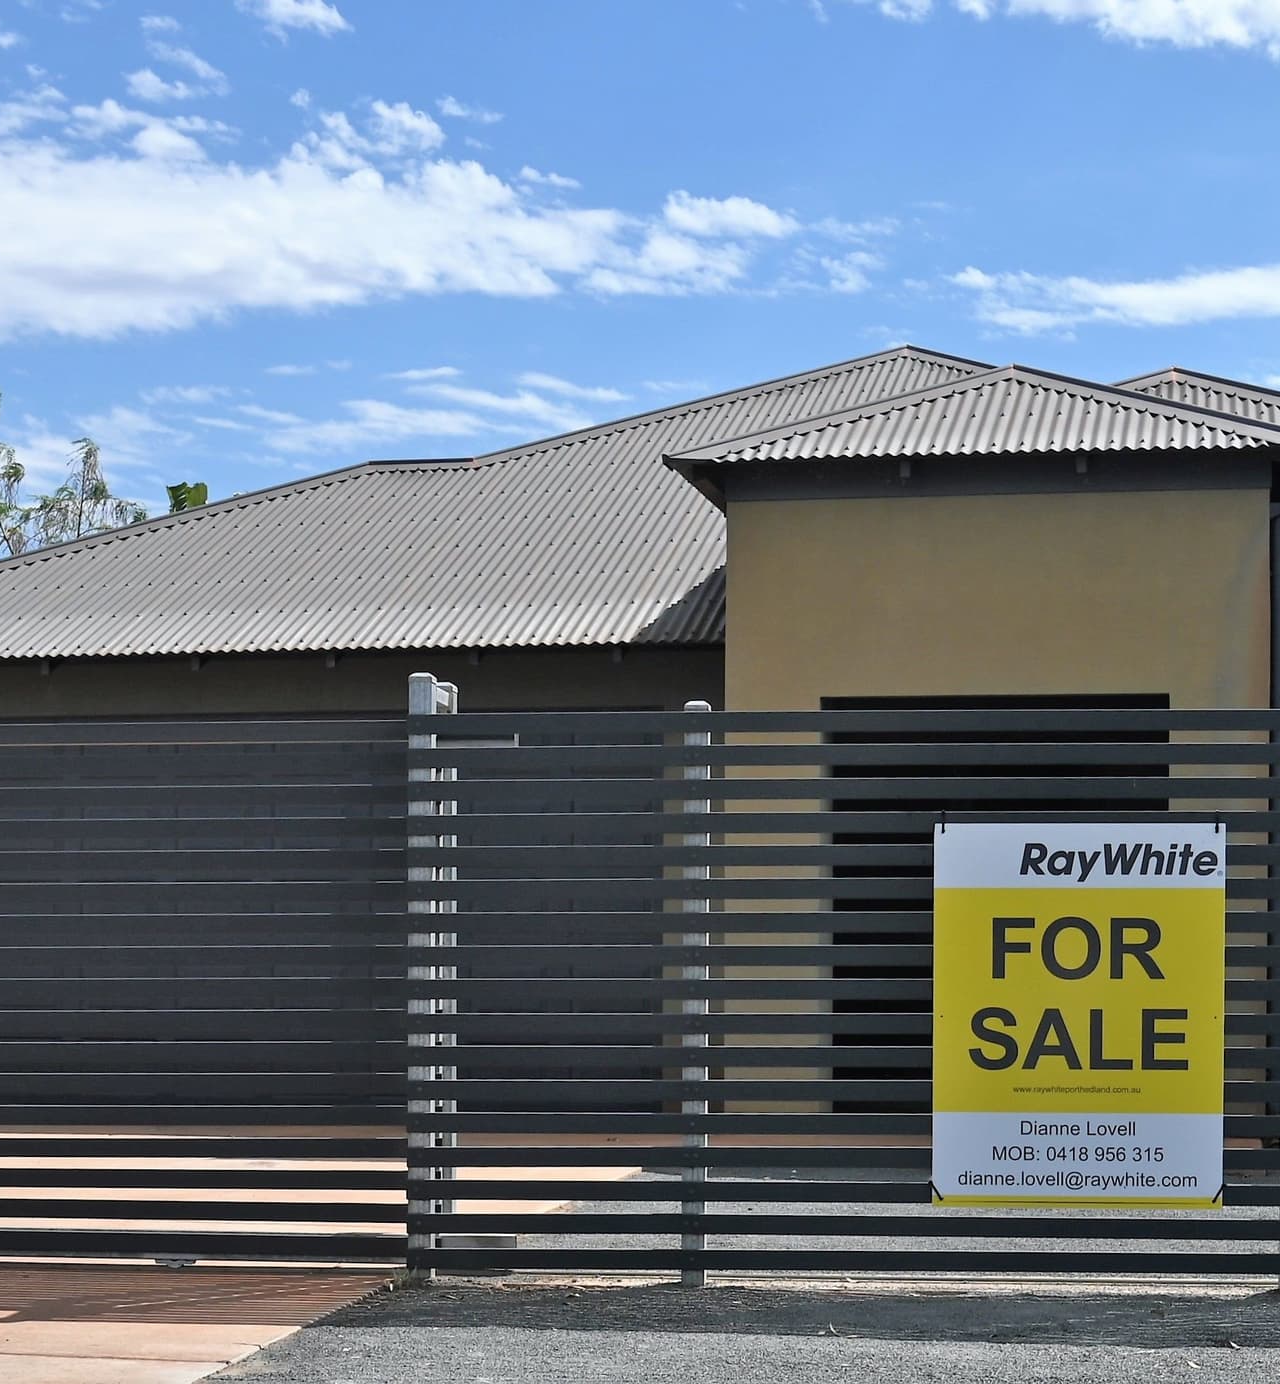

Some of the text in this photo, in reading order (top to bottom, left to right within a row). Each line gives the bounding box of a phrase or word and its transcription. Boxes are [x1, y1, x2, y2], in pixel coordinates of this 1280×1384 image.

[1019, 842, 1218, 882] RayWhite
[991, 916, 1165, 980] FOR
[968, 1006, 1188, 1070] SALE
[1020, 1120, 1136, 1136] Dianne Lovell
[992, 1146, 1163, 1161] MOB: 0418 956 315
[957, 1170, 1197, 1190] dianne.lovell@raywhite.com
